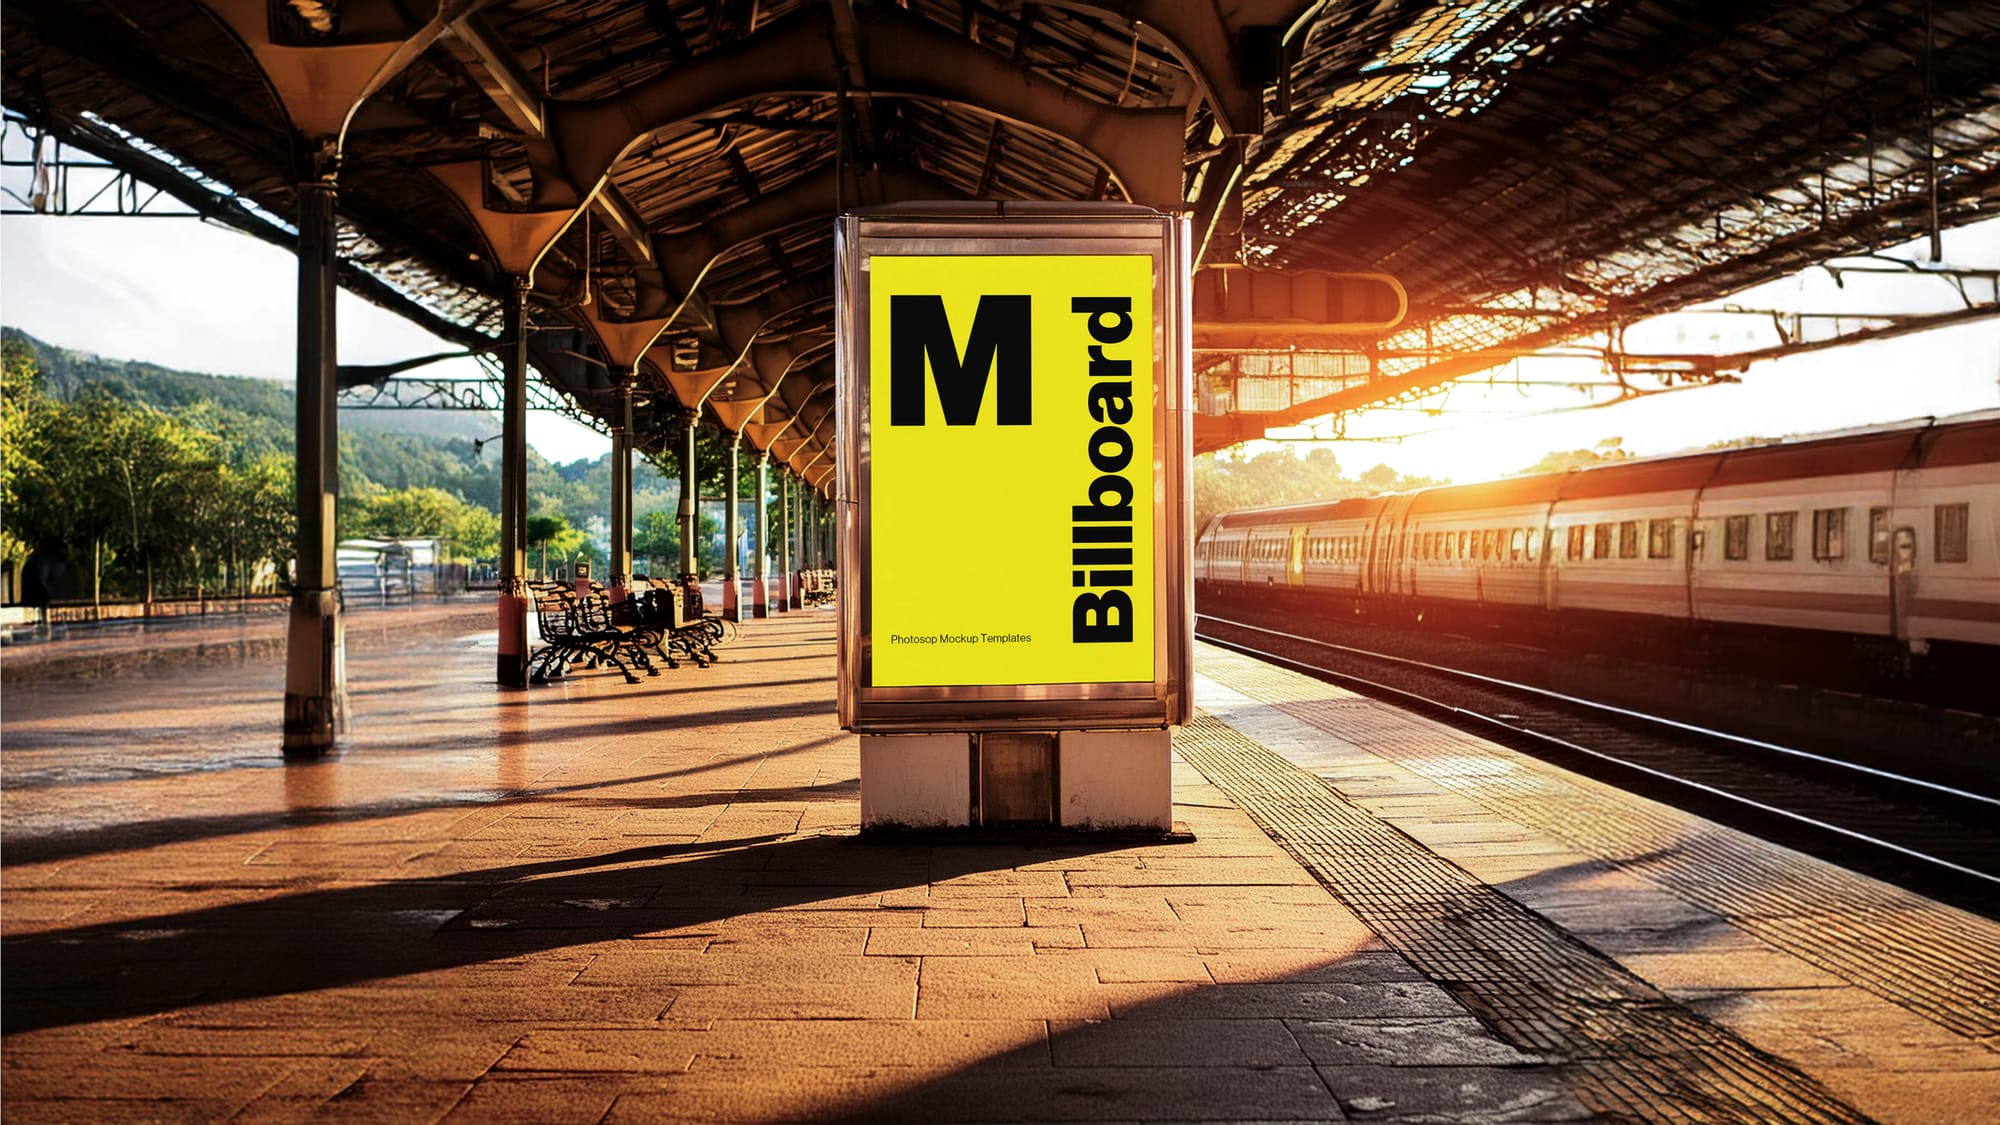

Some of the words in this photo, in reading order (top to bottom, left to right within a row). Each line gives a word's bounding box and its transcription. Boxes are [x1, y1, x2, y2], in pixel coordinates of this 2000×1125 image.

[890, 294, 1033, 427] M
[1071, 296, 1134, 644] Billboard
[890, 634, 938, 645] Photosop
[939, 633, 979, 645] Mockup
[980, 633, 1032, 644] Templates
